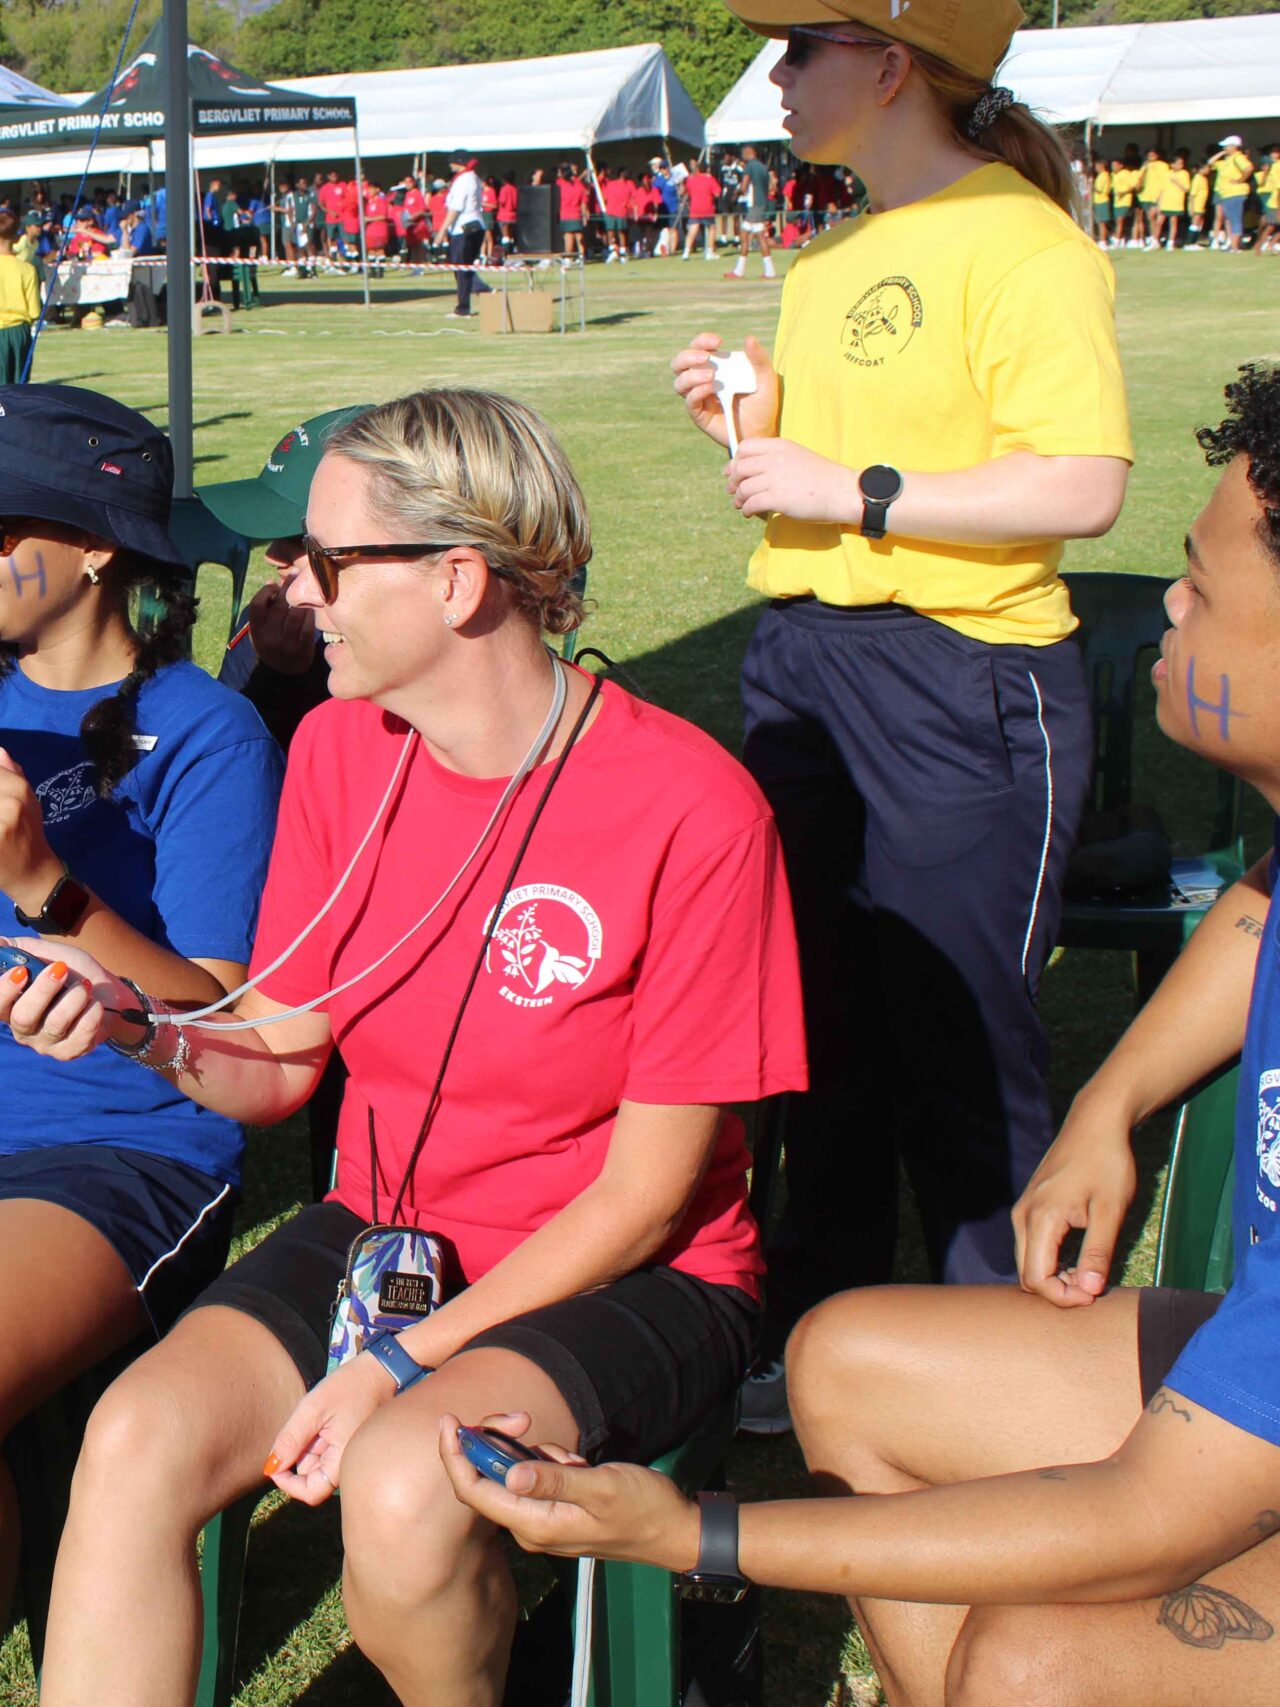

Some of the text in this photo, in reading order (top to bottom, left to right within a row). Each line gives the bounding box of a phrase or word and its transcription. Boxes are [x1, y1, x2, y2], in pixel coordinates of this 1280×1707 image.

[58, 113, 120, 132] PRIMARY
[123, 111, 165, 128] SCHO
[198, 106, 353, 123] BERGVLIET PRIMARY SCHOOL
[8, 550, 47, 599] H
[1185, 655, 1248, 741] H
[532, 885, 582, 906] PRIMARY
[581, 906, 599, 951] SCHOOL
[498, 985, 554, 1008] EKSTEEN
[388, 1285, 425, 1303] TEACHER
